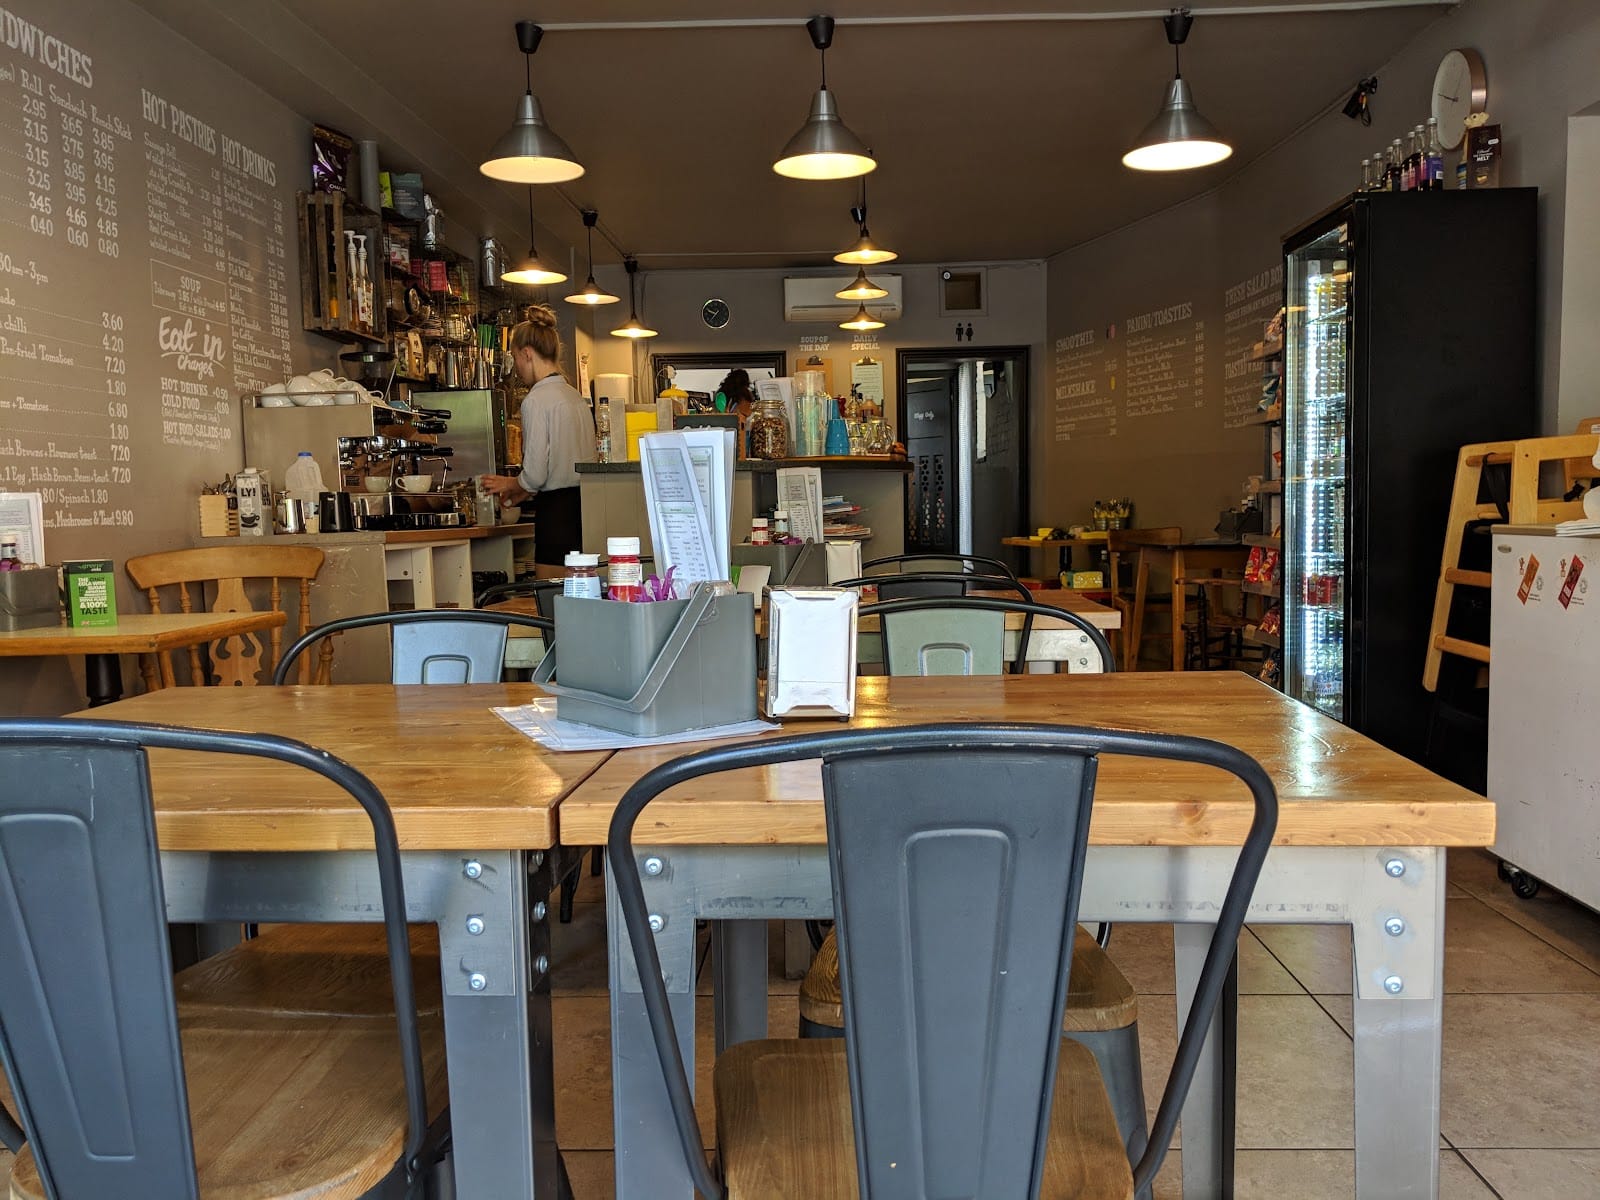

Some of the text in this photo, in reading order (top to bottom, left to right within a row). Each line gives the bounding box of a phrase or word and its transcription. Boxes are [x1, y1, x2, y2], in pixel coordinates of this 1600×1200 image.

[20, 68, 43, 97] Roll
[48, 83, 88, 119] Sandwich
[141, 87, 216, 156] HOT PASTRIES
[221, 134, 277, 187] HOT DRINKS
[180, 276, 201, 293] SOUP
[102, 312, 124, 331] 3.60
[102, 333, 124, 353] 4.20
[159, 316, 226, 361] Eat in
[800, 335, 819, 344] SOUP
[800, 343, 830, 352] THE DAY
[851, 342, 880, 352] SPECIAL
[853, 334, 878, 343] DAILY
[39, 344, 74, 366] Tomatoes
[104, 356, 126, 375] 7.20
[106, 378, 127, 396] 1.80
[160, 376, 178, 392] HOT
[180, 380, 208, 397] DRINKS
[1055, 380, 1097, 400] MILKSHAKE
[16, 396, 49, 411] Tomatoes
[108, 401, 128, 418] 6.80
[161, 392, 181, 409] COLD
[182, 396, 200, 411] FOOD
[109, 422, 129, 440] 1.80
[163, 421, 178, 435] HOT
[111, 444, 131, 462] 7.20
[11, 466, 26, 486] Egg
[111, 466, 131, 484] 7.20
[91, 488, 109, 504] 1.80
[241, 487, 256, 497] LY!
[115, 509, 134, 527] 9.80
